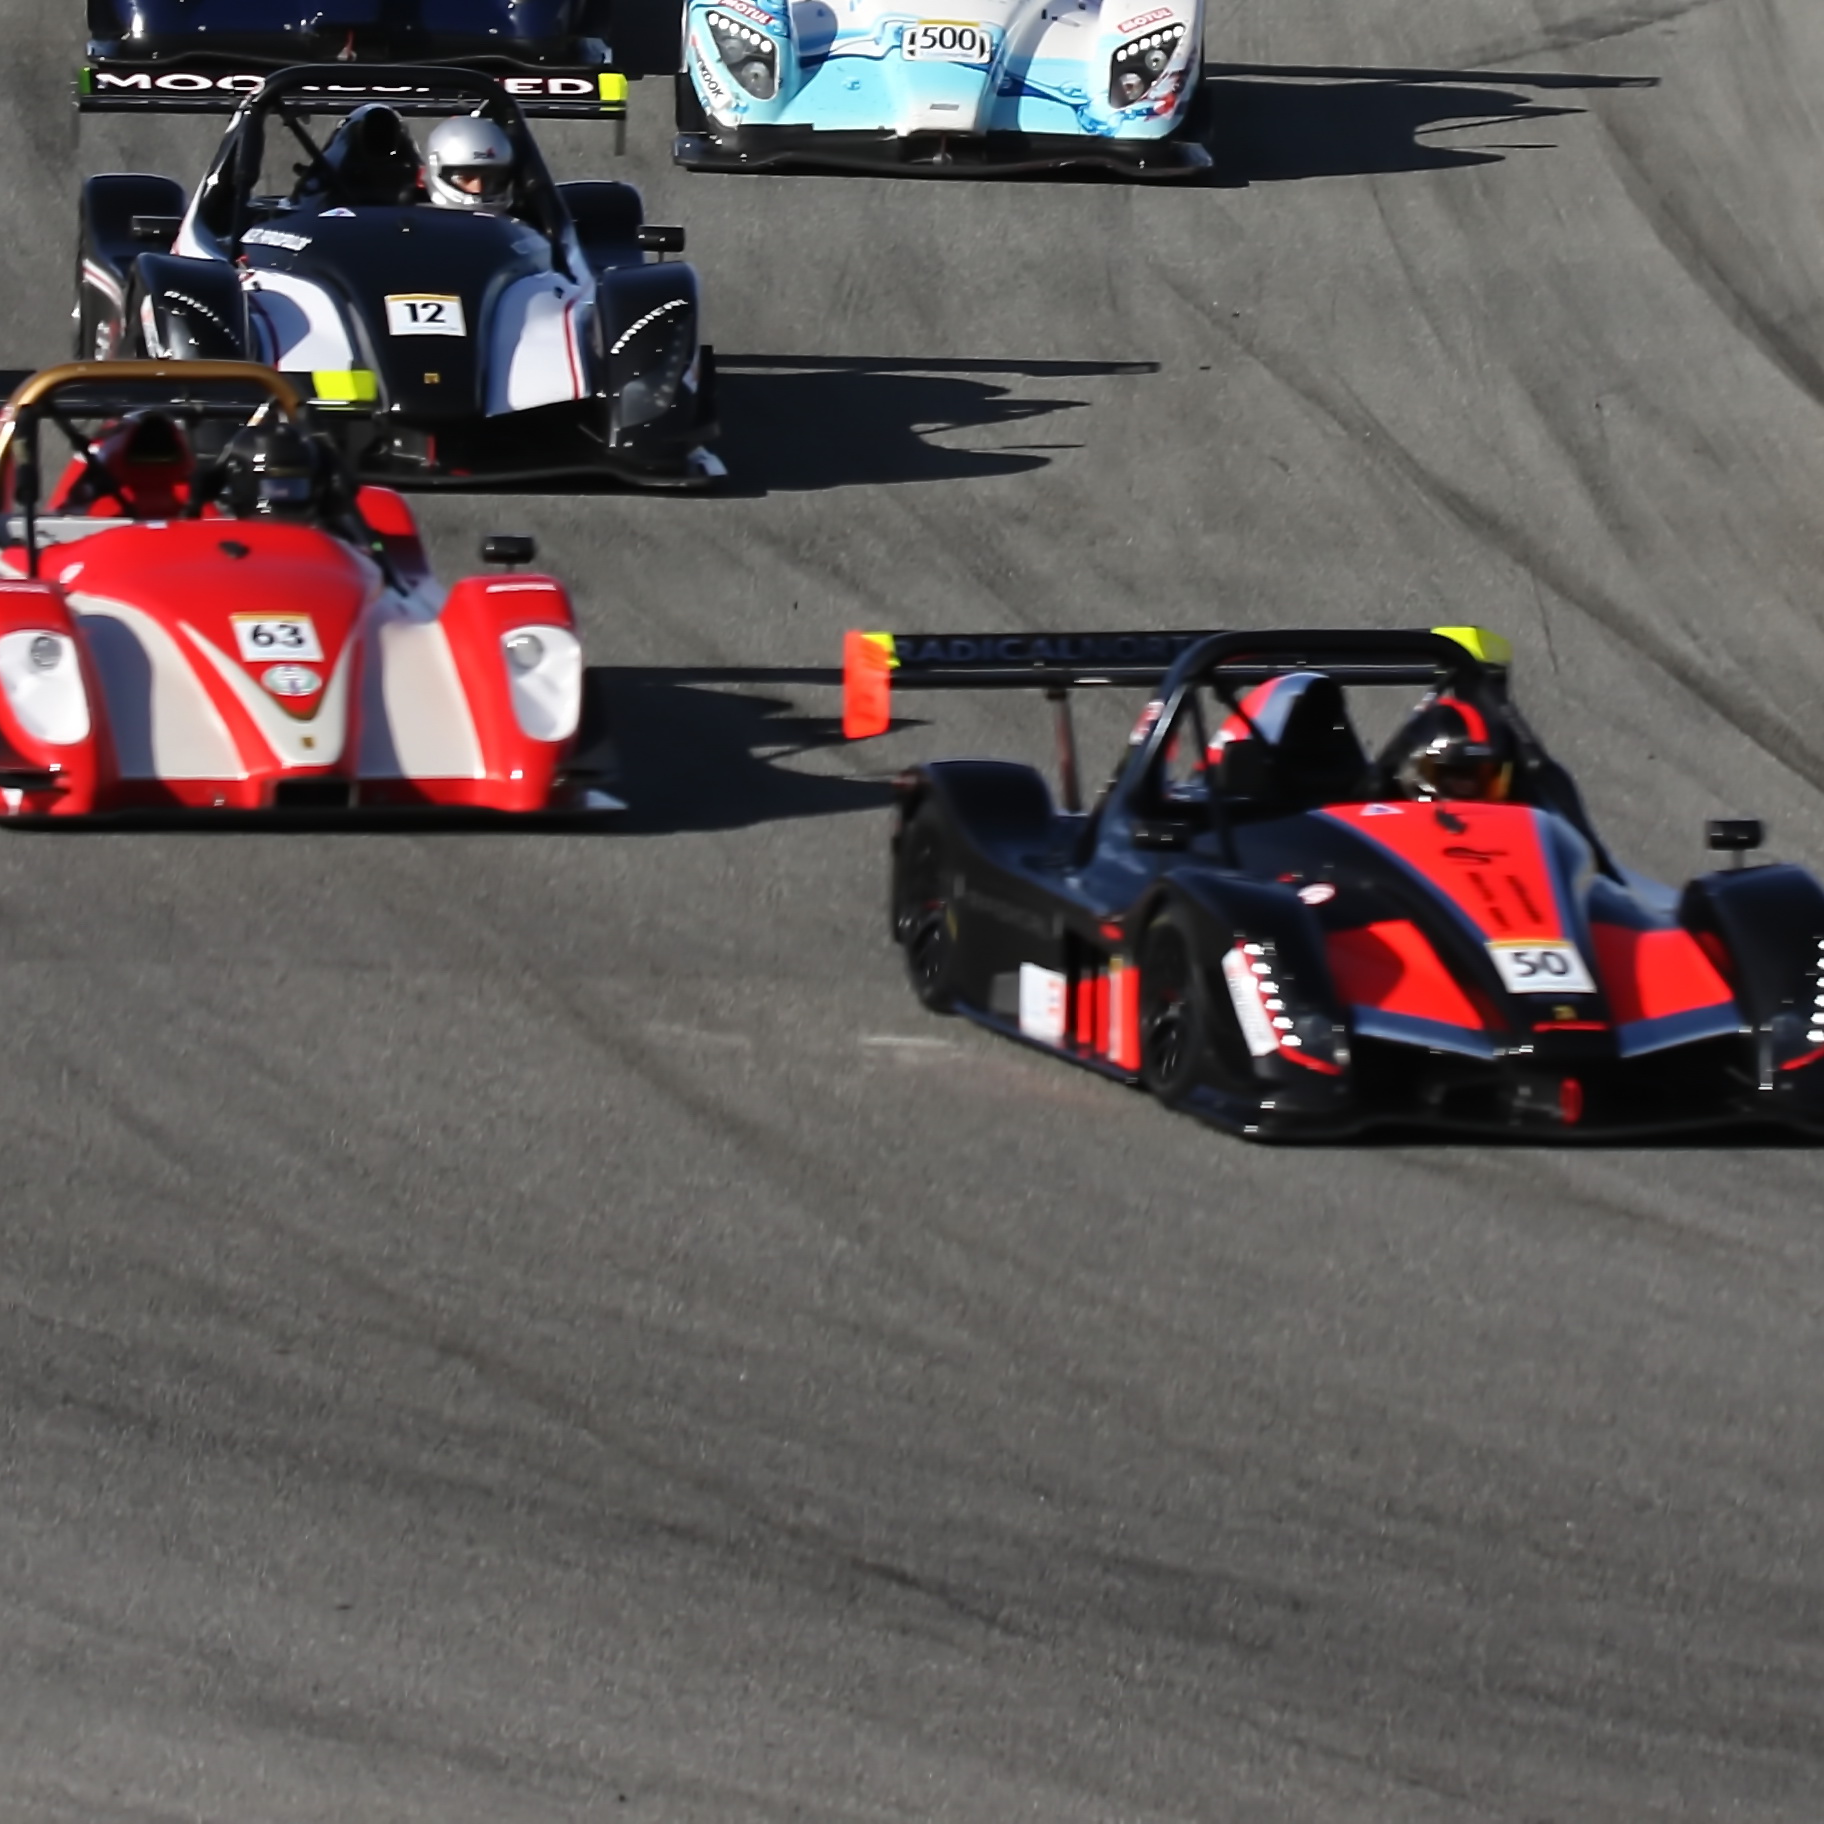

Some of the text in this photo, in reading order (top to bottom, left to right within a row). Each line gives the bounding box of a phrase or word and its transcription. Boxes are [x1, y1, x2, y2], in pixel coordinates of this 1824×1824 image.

[920, 26, 977, 51] 500
[95, 72, 594, 96] MOOED
[404, 302, 447, 324] 12
[251, 623, 306, 648] 63
[1512, 950, 1570, 977] 50
